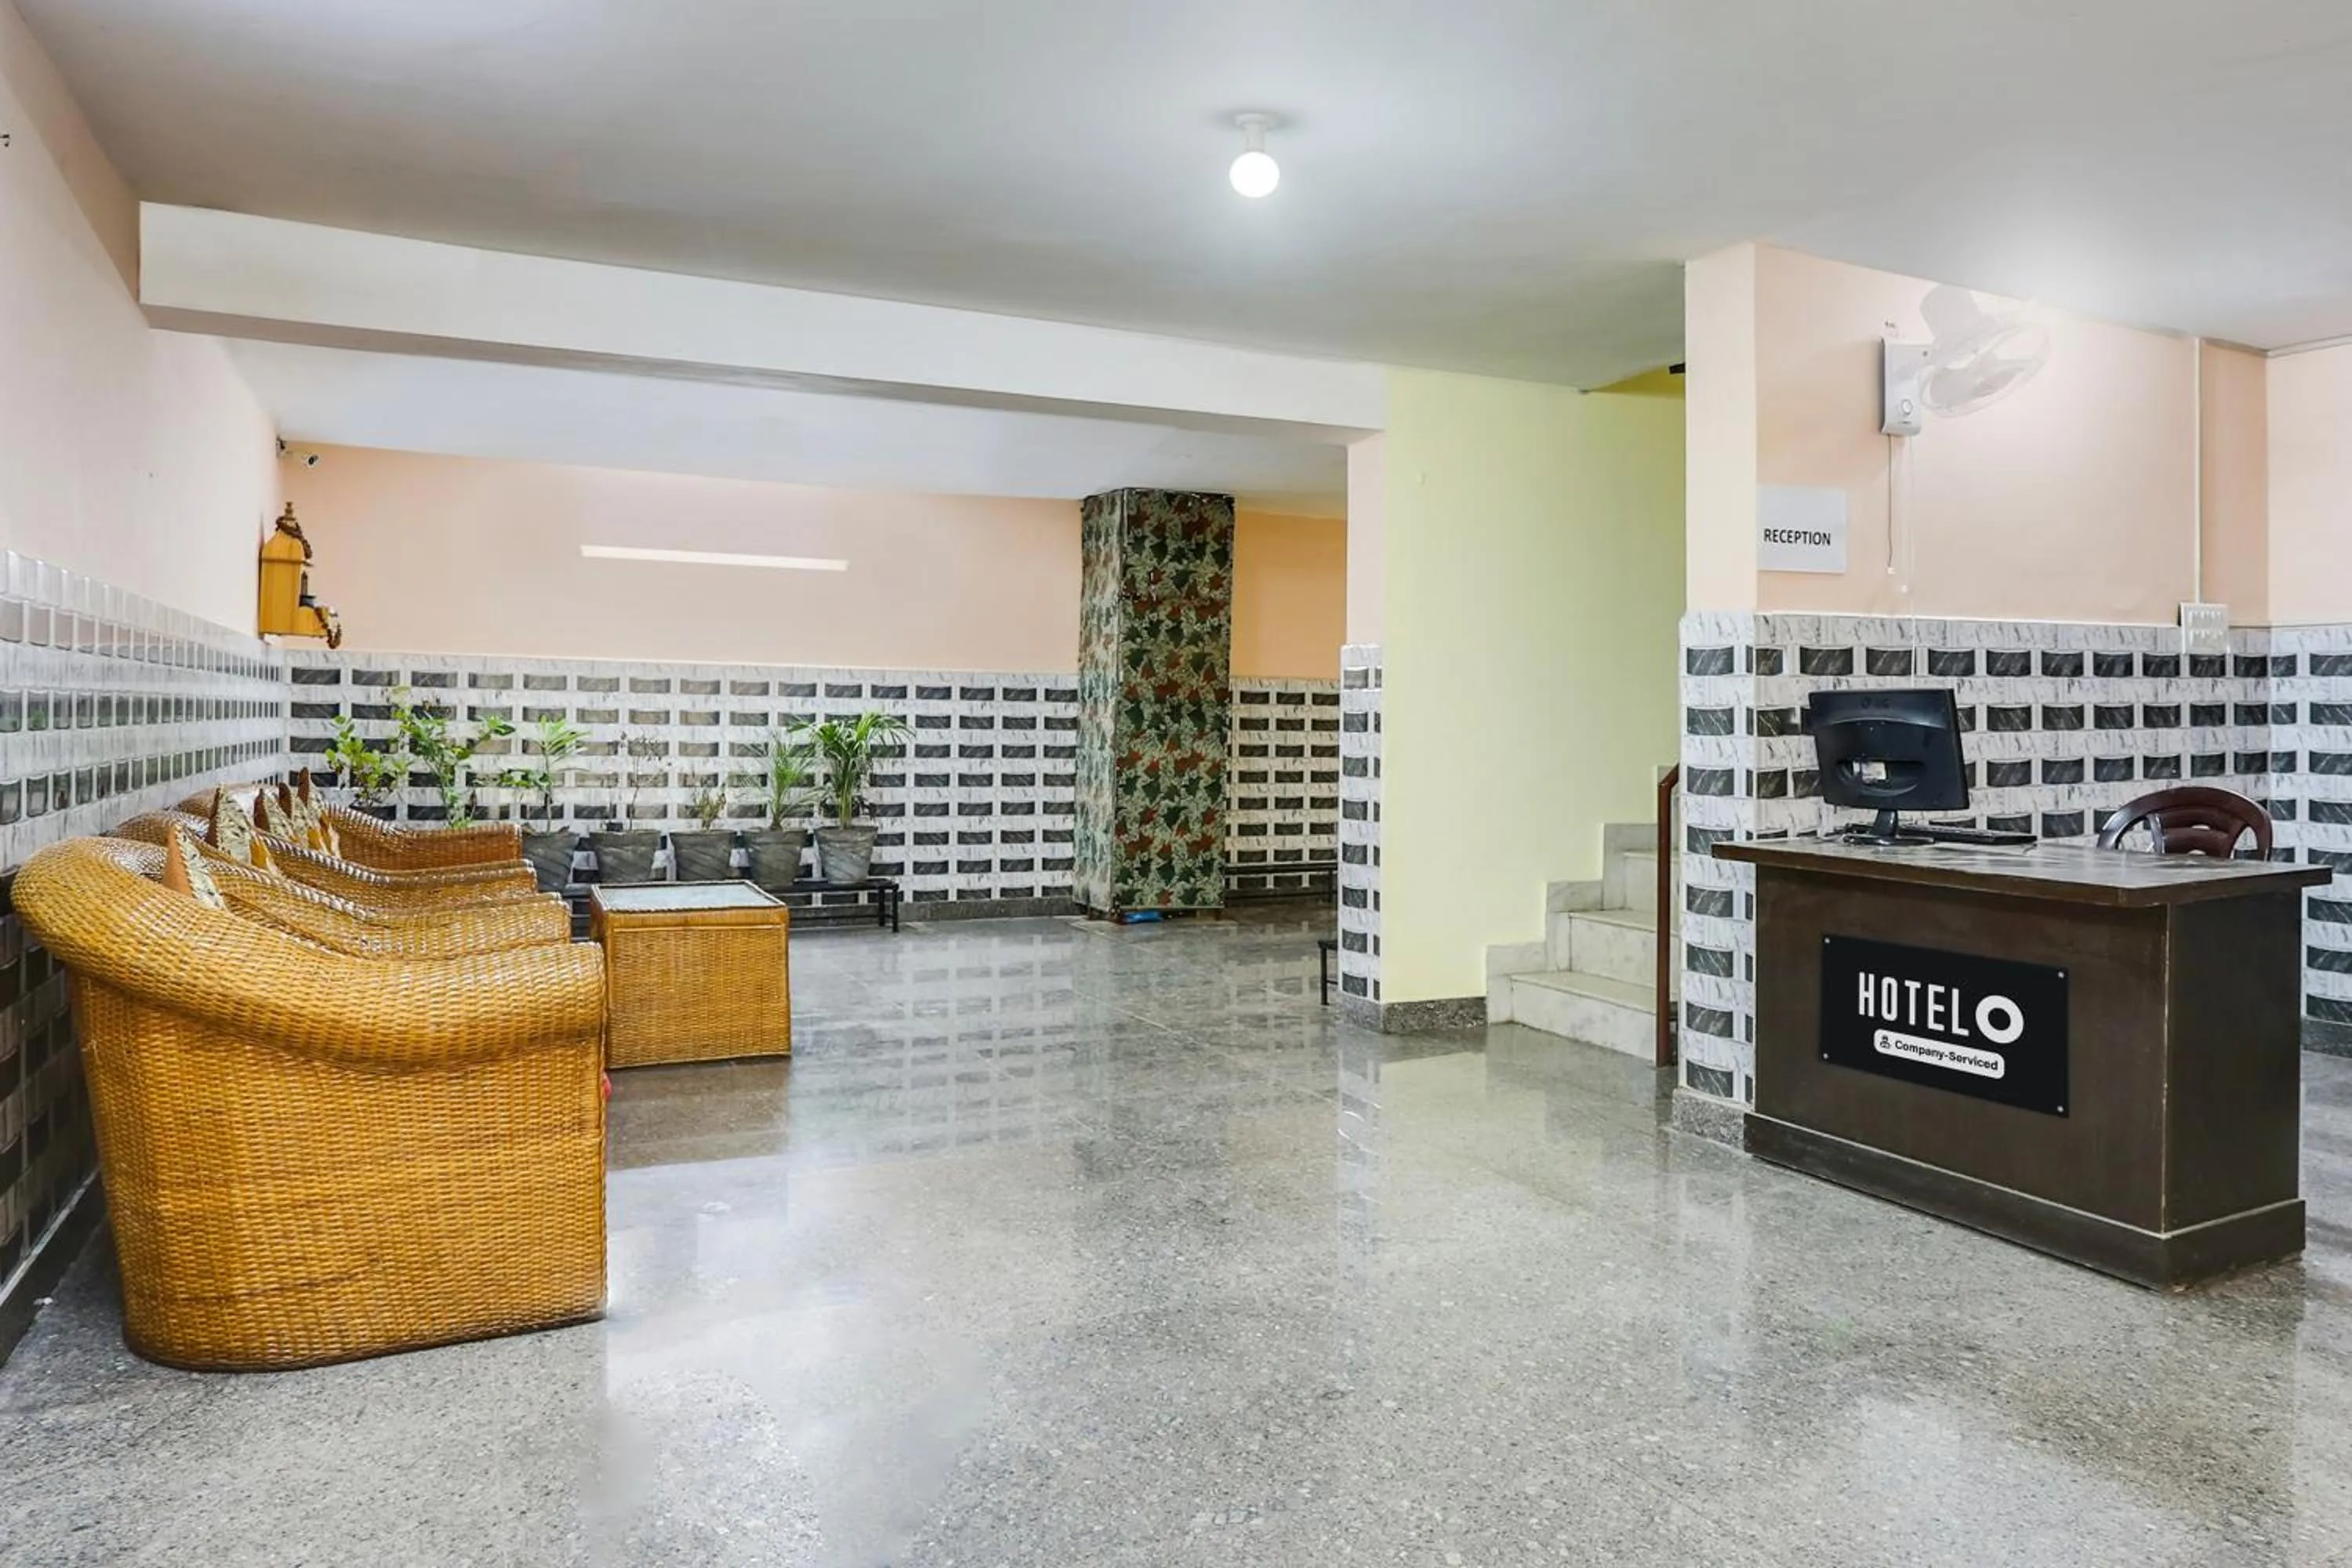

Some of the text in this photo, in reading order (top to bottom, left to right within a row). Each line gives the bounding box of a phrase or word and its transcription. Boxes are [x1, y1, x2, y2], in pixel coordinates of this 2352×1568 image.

[1763, 528, 1831, 546] RECEPTION
[1859, 971, 1969, 1036] HOTEL
[1894, 1040, 1998, 1071] Company-Serviced
